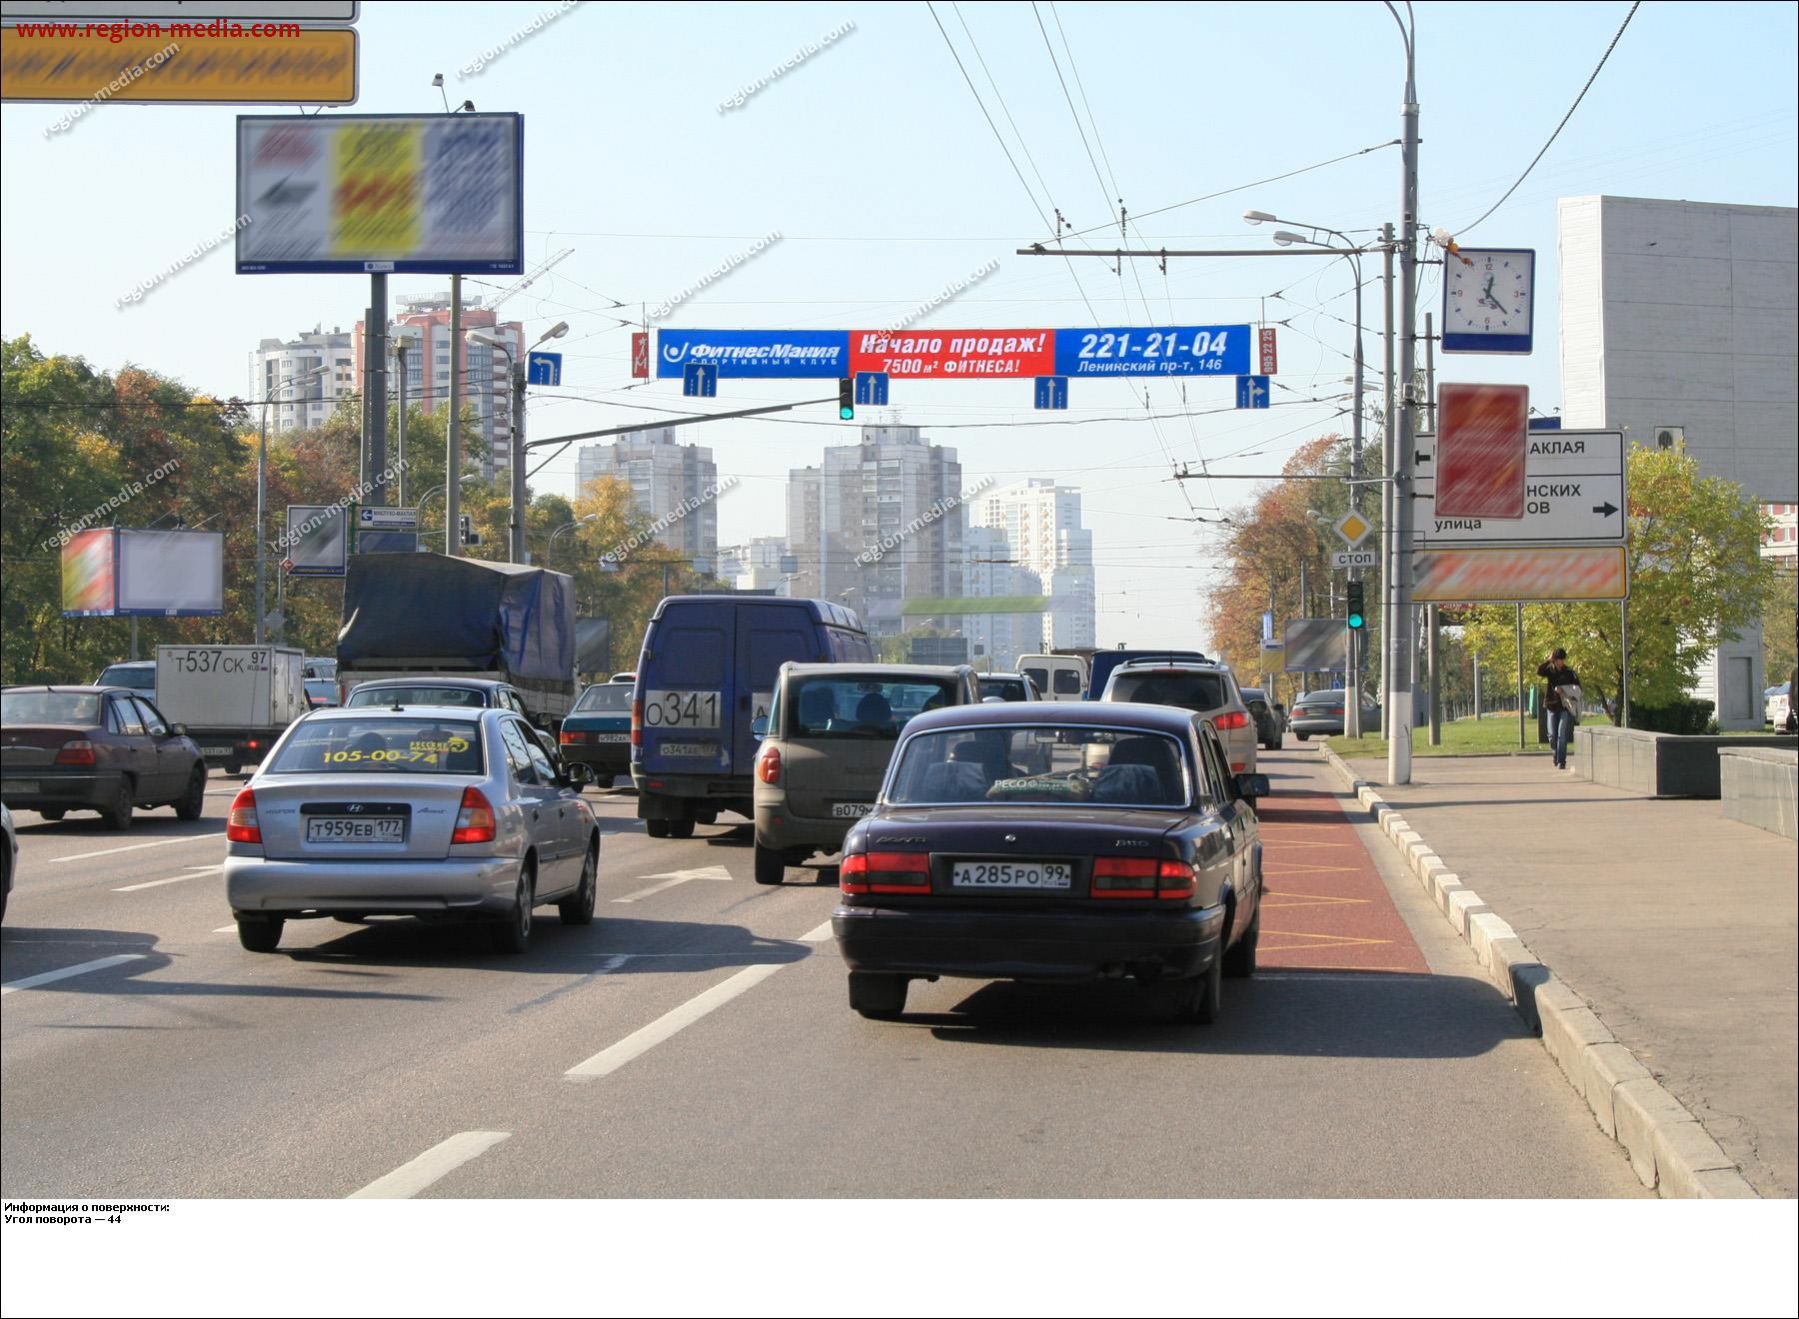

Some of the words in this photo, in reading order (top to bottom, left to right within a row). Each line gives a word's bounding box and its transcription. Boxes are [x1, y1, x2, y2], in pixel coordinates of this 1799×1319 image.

[690, 343, 840, 359] ФитнесМания
[859, 334, 942, 354] Начало
[950, 333, 1046, 357] продаж!
[1078, 332, 1228, 358] 221-21-04
[800, 358, 838, 366] КЛУБ
[882, 359, 923, 373] 7500
[944, 359, 1020, 373] ФИТНЕСА!
[1077, 360, 1155, 372] Ленинский
[1159, 361, 1194, 374] пр-т,
[1200, 359, 1222, 370] 146
[1435, 519, 1482, 532] улица
[1338, 554, 1371, 564] СТОП
[251, 652, 267, 664] 97
[323, 750, 438, 764] 105-00-74
[377, 820, 400, 832] 177
[1045, 866, 1065, 880] 99
